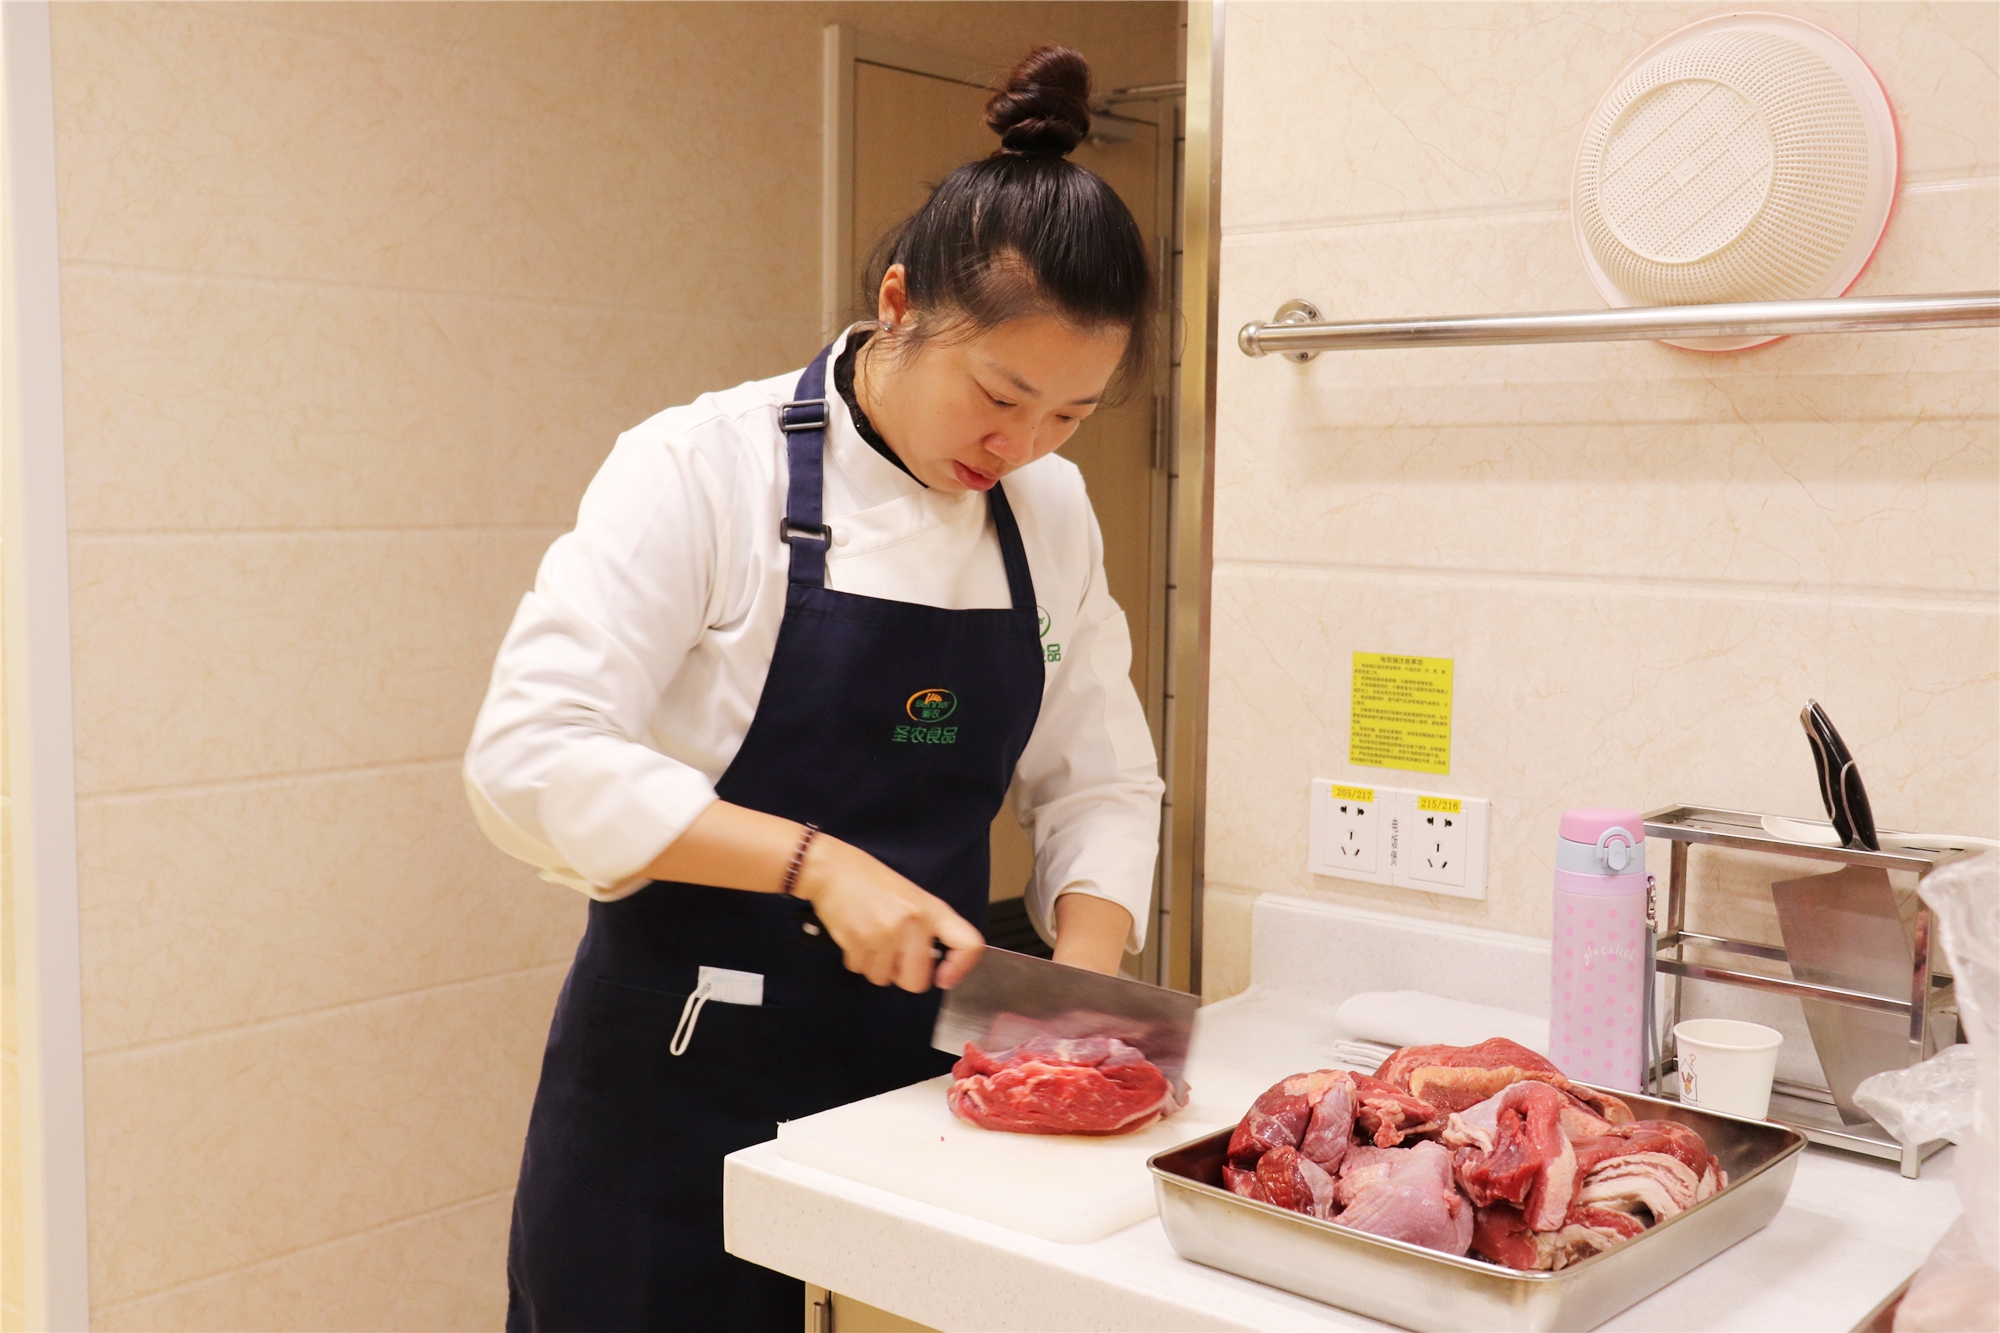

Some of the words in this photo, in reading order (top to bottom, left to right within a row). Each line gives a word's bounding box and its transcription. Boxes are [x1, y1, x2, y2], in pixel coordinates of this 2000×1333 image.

[891, 725, 958, 744] 圣农食品
[1336, 788, 1372, 800] 205/217
[1421, 799, 1459, 810] 215/216
